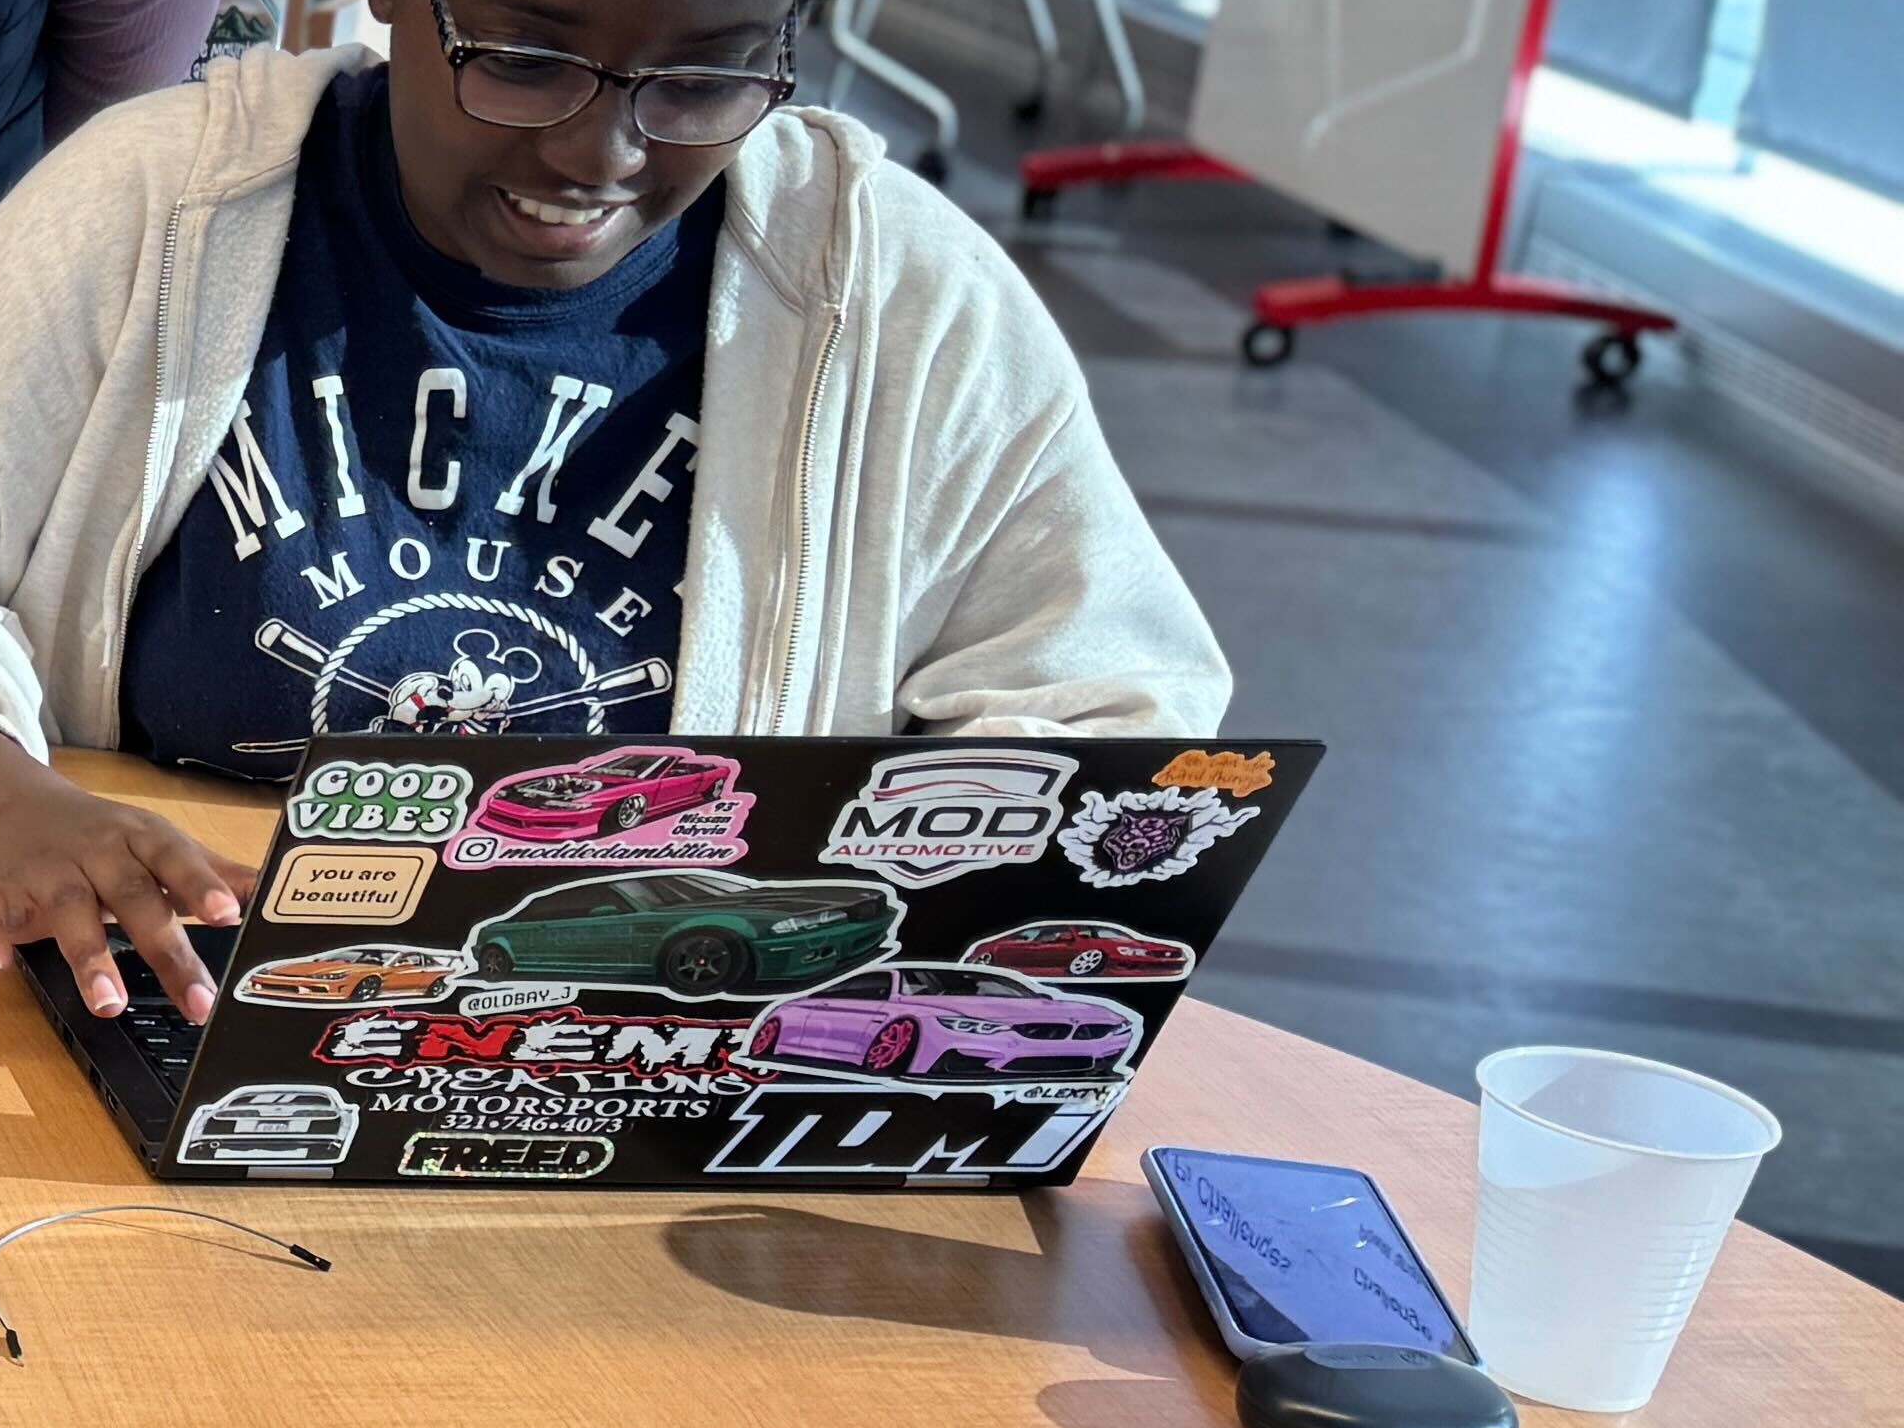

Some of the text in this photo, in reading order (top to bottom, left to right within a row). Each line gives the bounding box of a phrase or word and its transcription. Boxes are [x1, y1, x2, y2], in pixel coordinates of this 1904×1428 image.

[208, 368, 702, 562] MICKE
[300, 538, 653, 638] MOUSE
[314, 769, 460, 800] GOOD
[293, 802, 454, 833] VIBES
[679, 813, 732, 824] Nissan
[839, 806, 1052, 839] MOD
[830, 843, 1036, 857] AUTOMOTIVE
[309, 869, 396, 883] you are
[290, 888, 398, 905] beautiful
[368, 1094, 711, 1120] MOTORSPORTS
